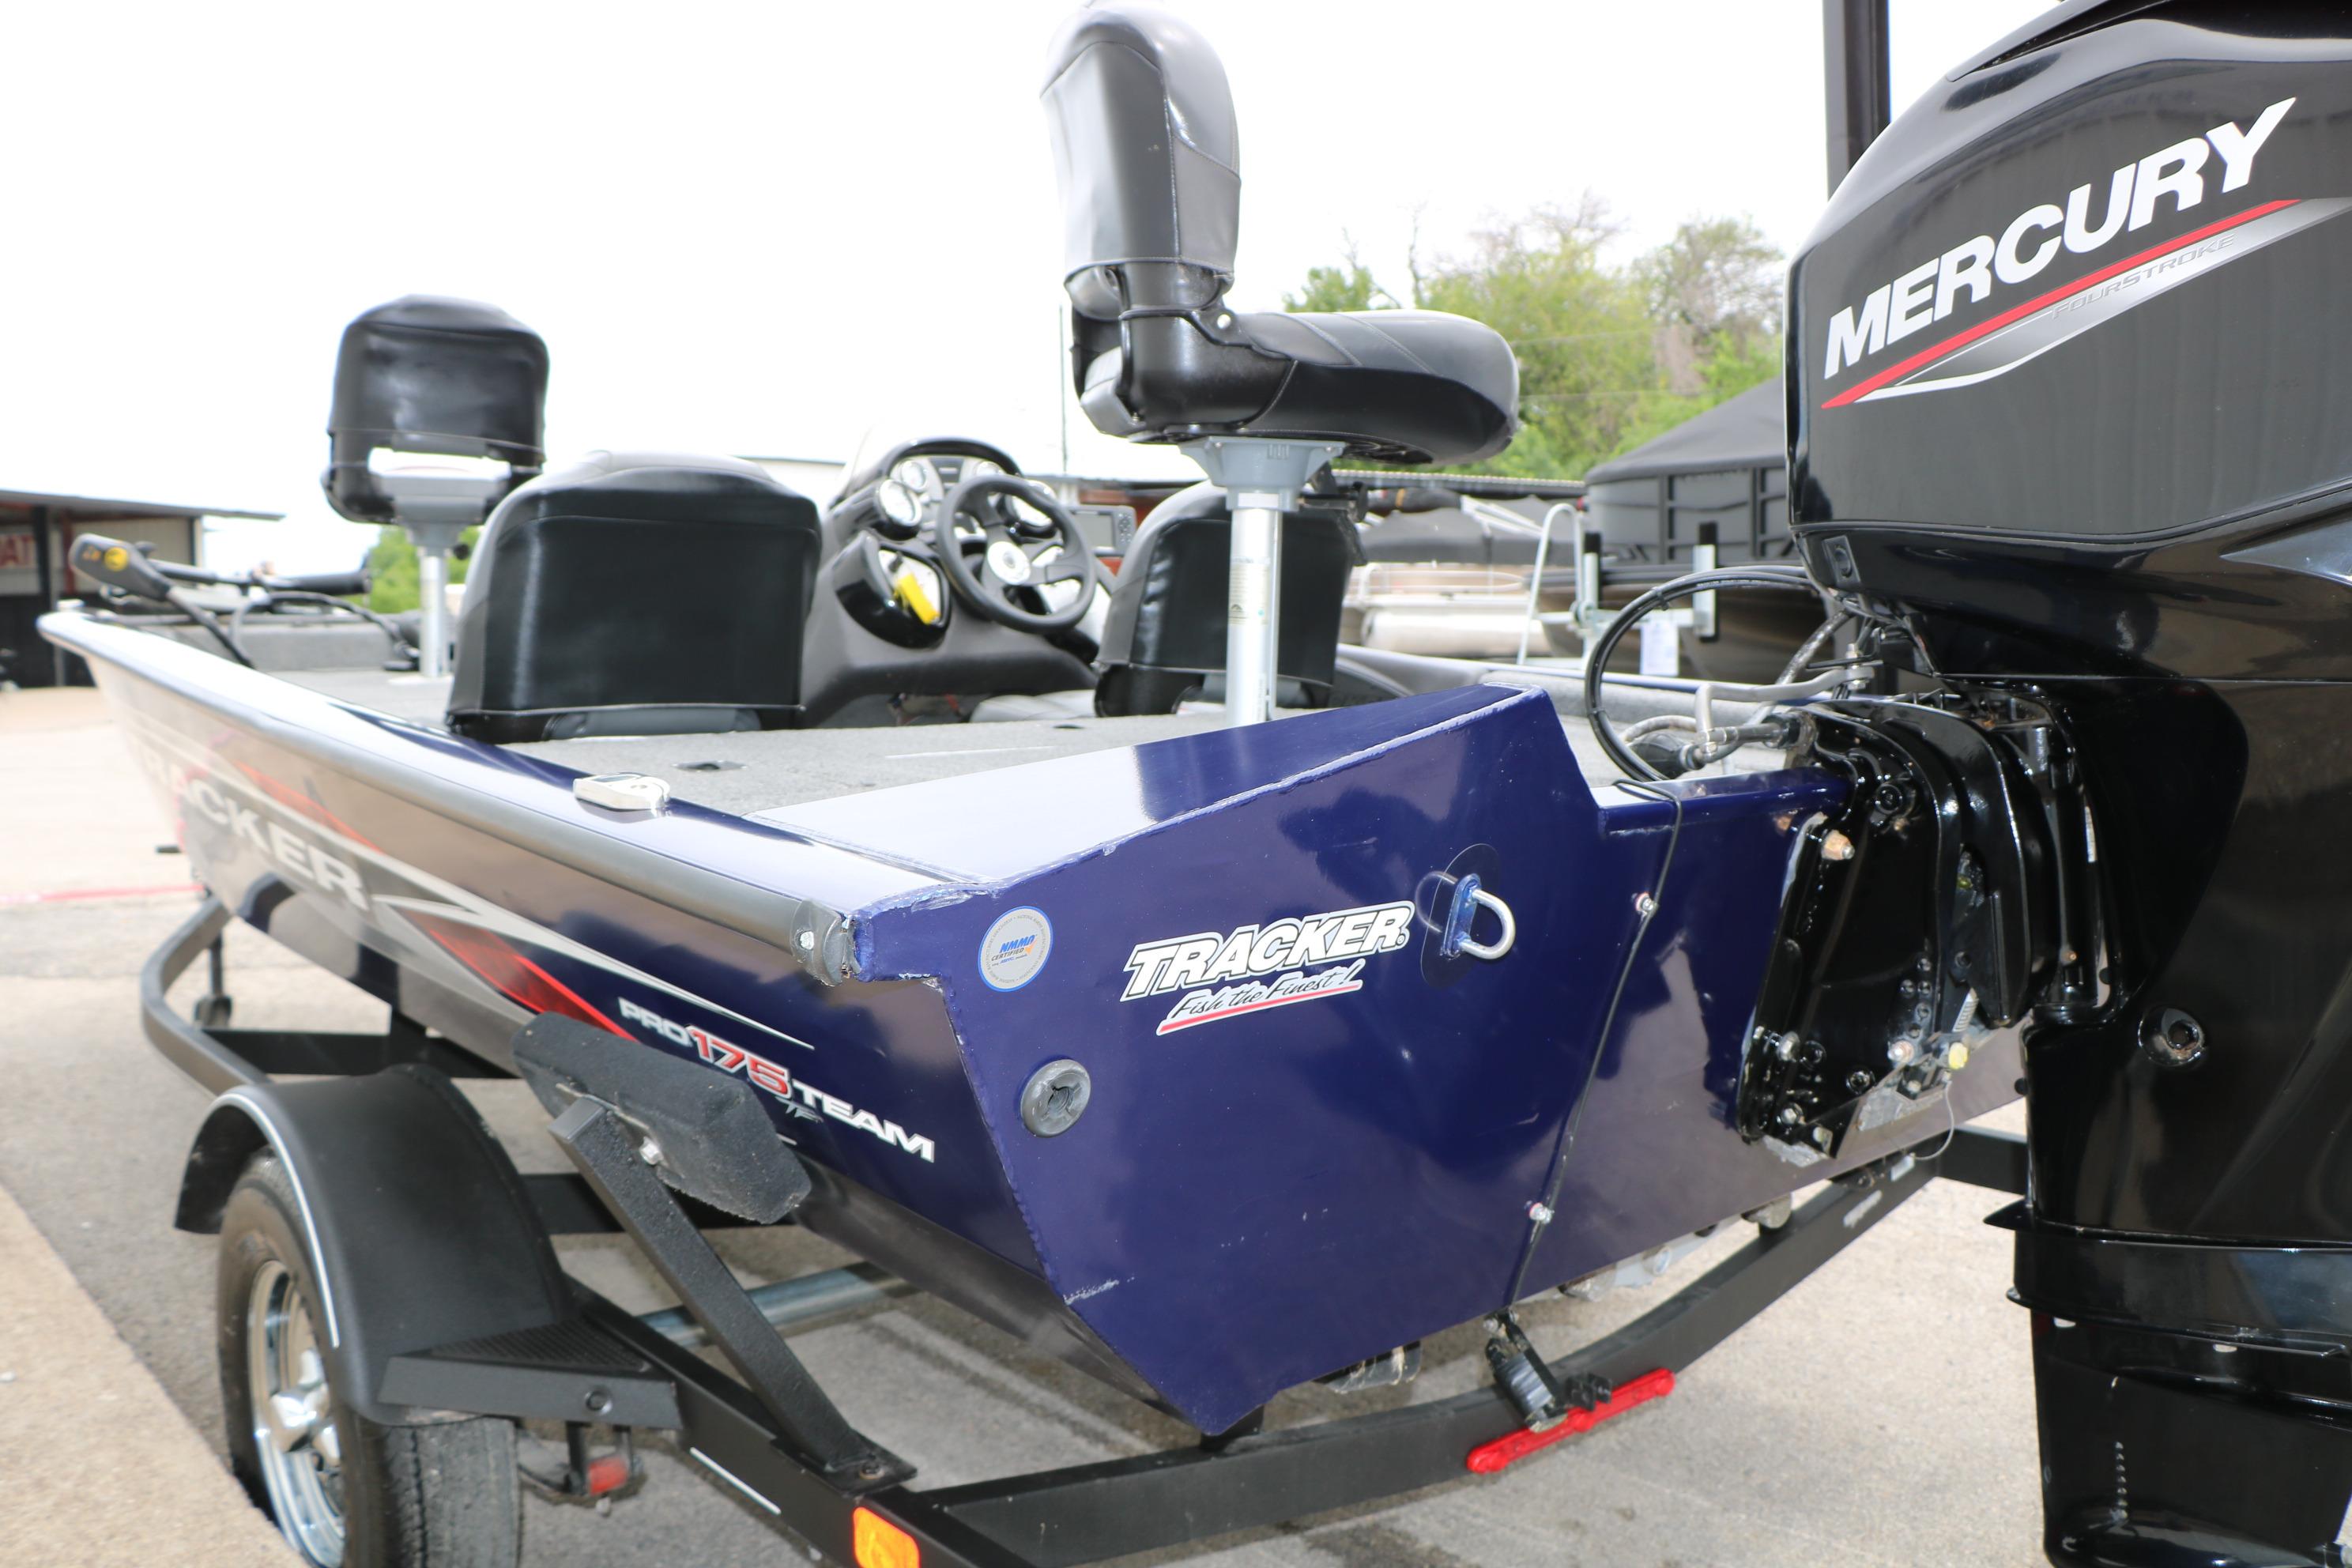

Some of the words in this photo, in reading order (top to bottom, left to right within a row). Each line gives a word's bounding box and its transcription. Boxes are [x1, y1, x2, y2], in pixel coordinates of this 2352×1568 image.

[1824, 96, 2297, 379] MERCURY
[2052, 233, 2236, 320] FOURSTROKE
[991, 947, 1024, 961] CERTIFIED
[1171, 992, 1226, 1020] Fish
[1228, 986, 1264, 1007] the
[618, 997, 693, 1048] PRO
[685, 1025, 792, 1101] 175
[792, 1079, 936, 1163] TEAM
